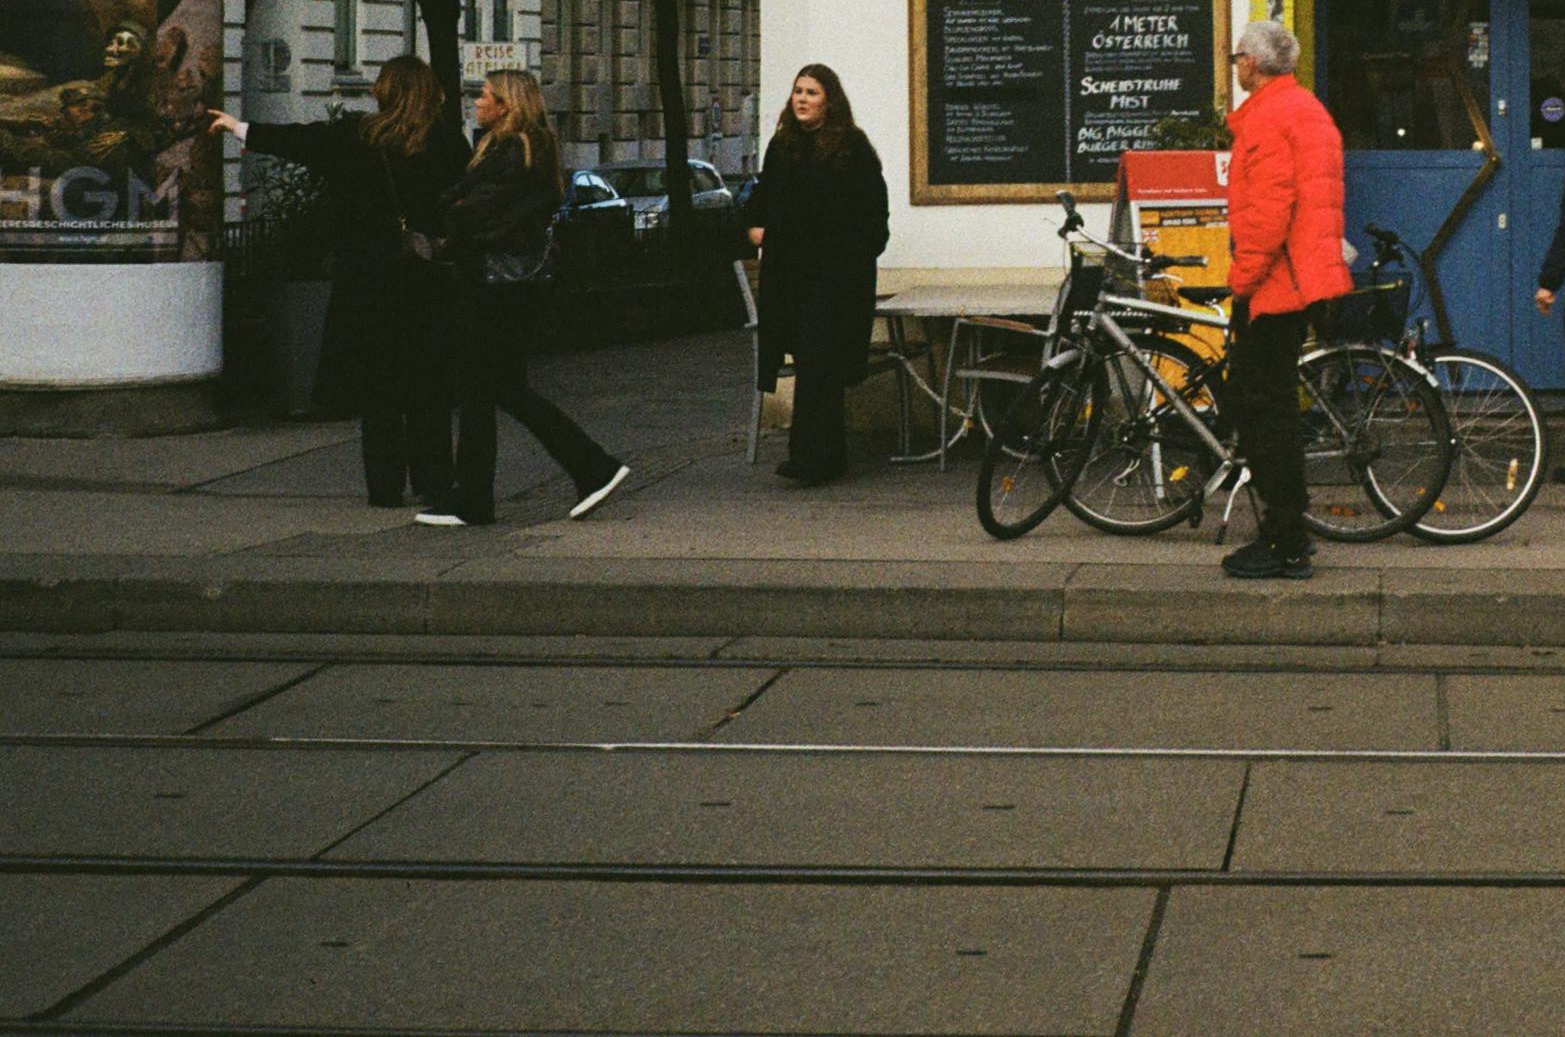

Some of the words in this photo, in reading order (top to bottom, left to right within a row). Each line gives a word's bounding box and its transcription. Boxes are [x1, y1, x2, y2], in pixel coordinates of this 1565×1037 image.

[1109, 15, 1120, 31] 1
[1124, 15, 1178, 32] METER
[1110, 95, 1151, 110] MIST
[1077, 139, 1129, 153] BURGER
[0, 166, 180, 221] HGM
[0, 219, 133, 229] ERESGESCHICHTLICHES
